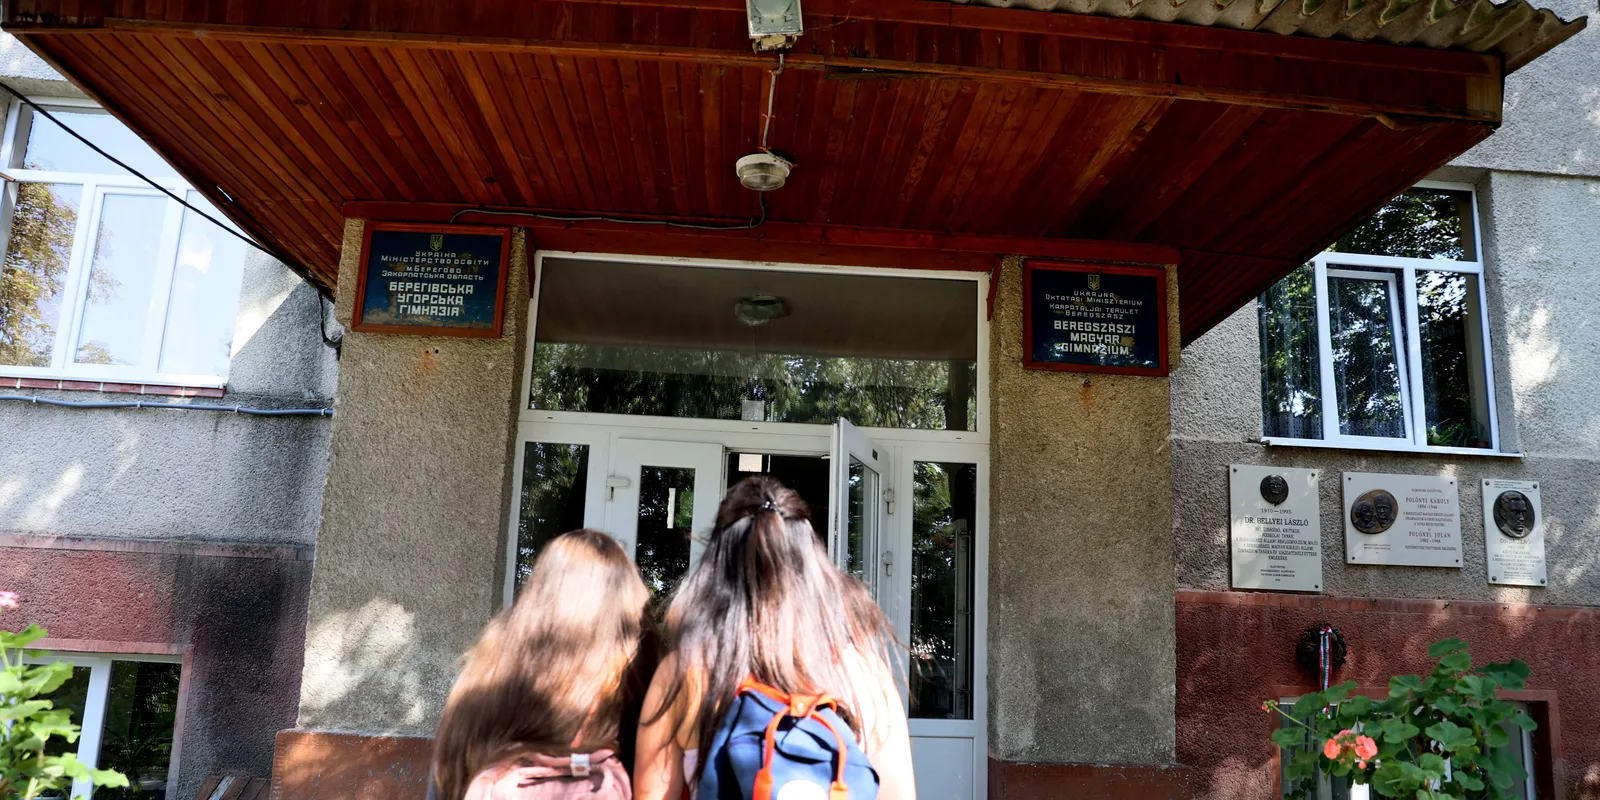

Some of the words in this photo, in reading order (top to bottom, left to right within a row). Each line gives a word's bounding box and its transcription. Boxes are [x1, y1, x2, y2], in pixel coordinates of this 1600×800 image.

[381, 255, 451, 264] МІНІСТЕРСТВО
[382, 270, 444, 279] ЗАКАРПАТСЬКА
[389, 282, 474, 294] БЕРЕГІВСЬКА
[397, 293, 464, 305] УГОРСЬКА
[1074, 290, 1114, 298] UKRAJNA
[400, 305, 459, 316] ГІМНАЗІЯ
[1054, 320, 1135, 334] BEREGSZÁSZI
[1070, 332, 1120, 344] MAGYAR
[1062, 343, 1129, 355] GIMNÁZIUM
[1285, 518, 1309, 526] LÁSZLÓ
